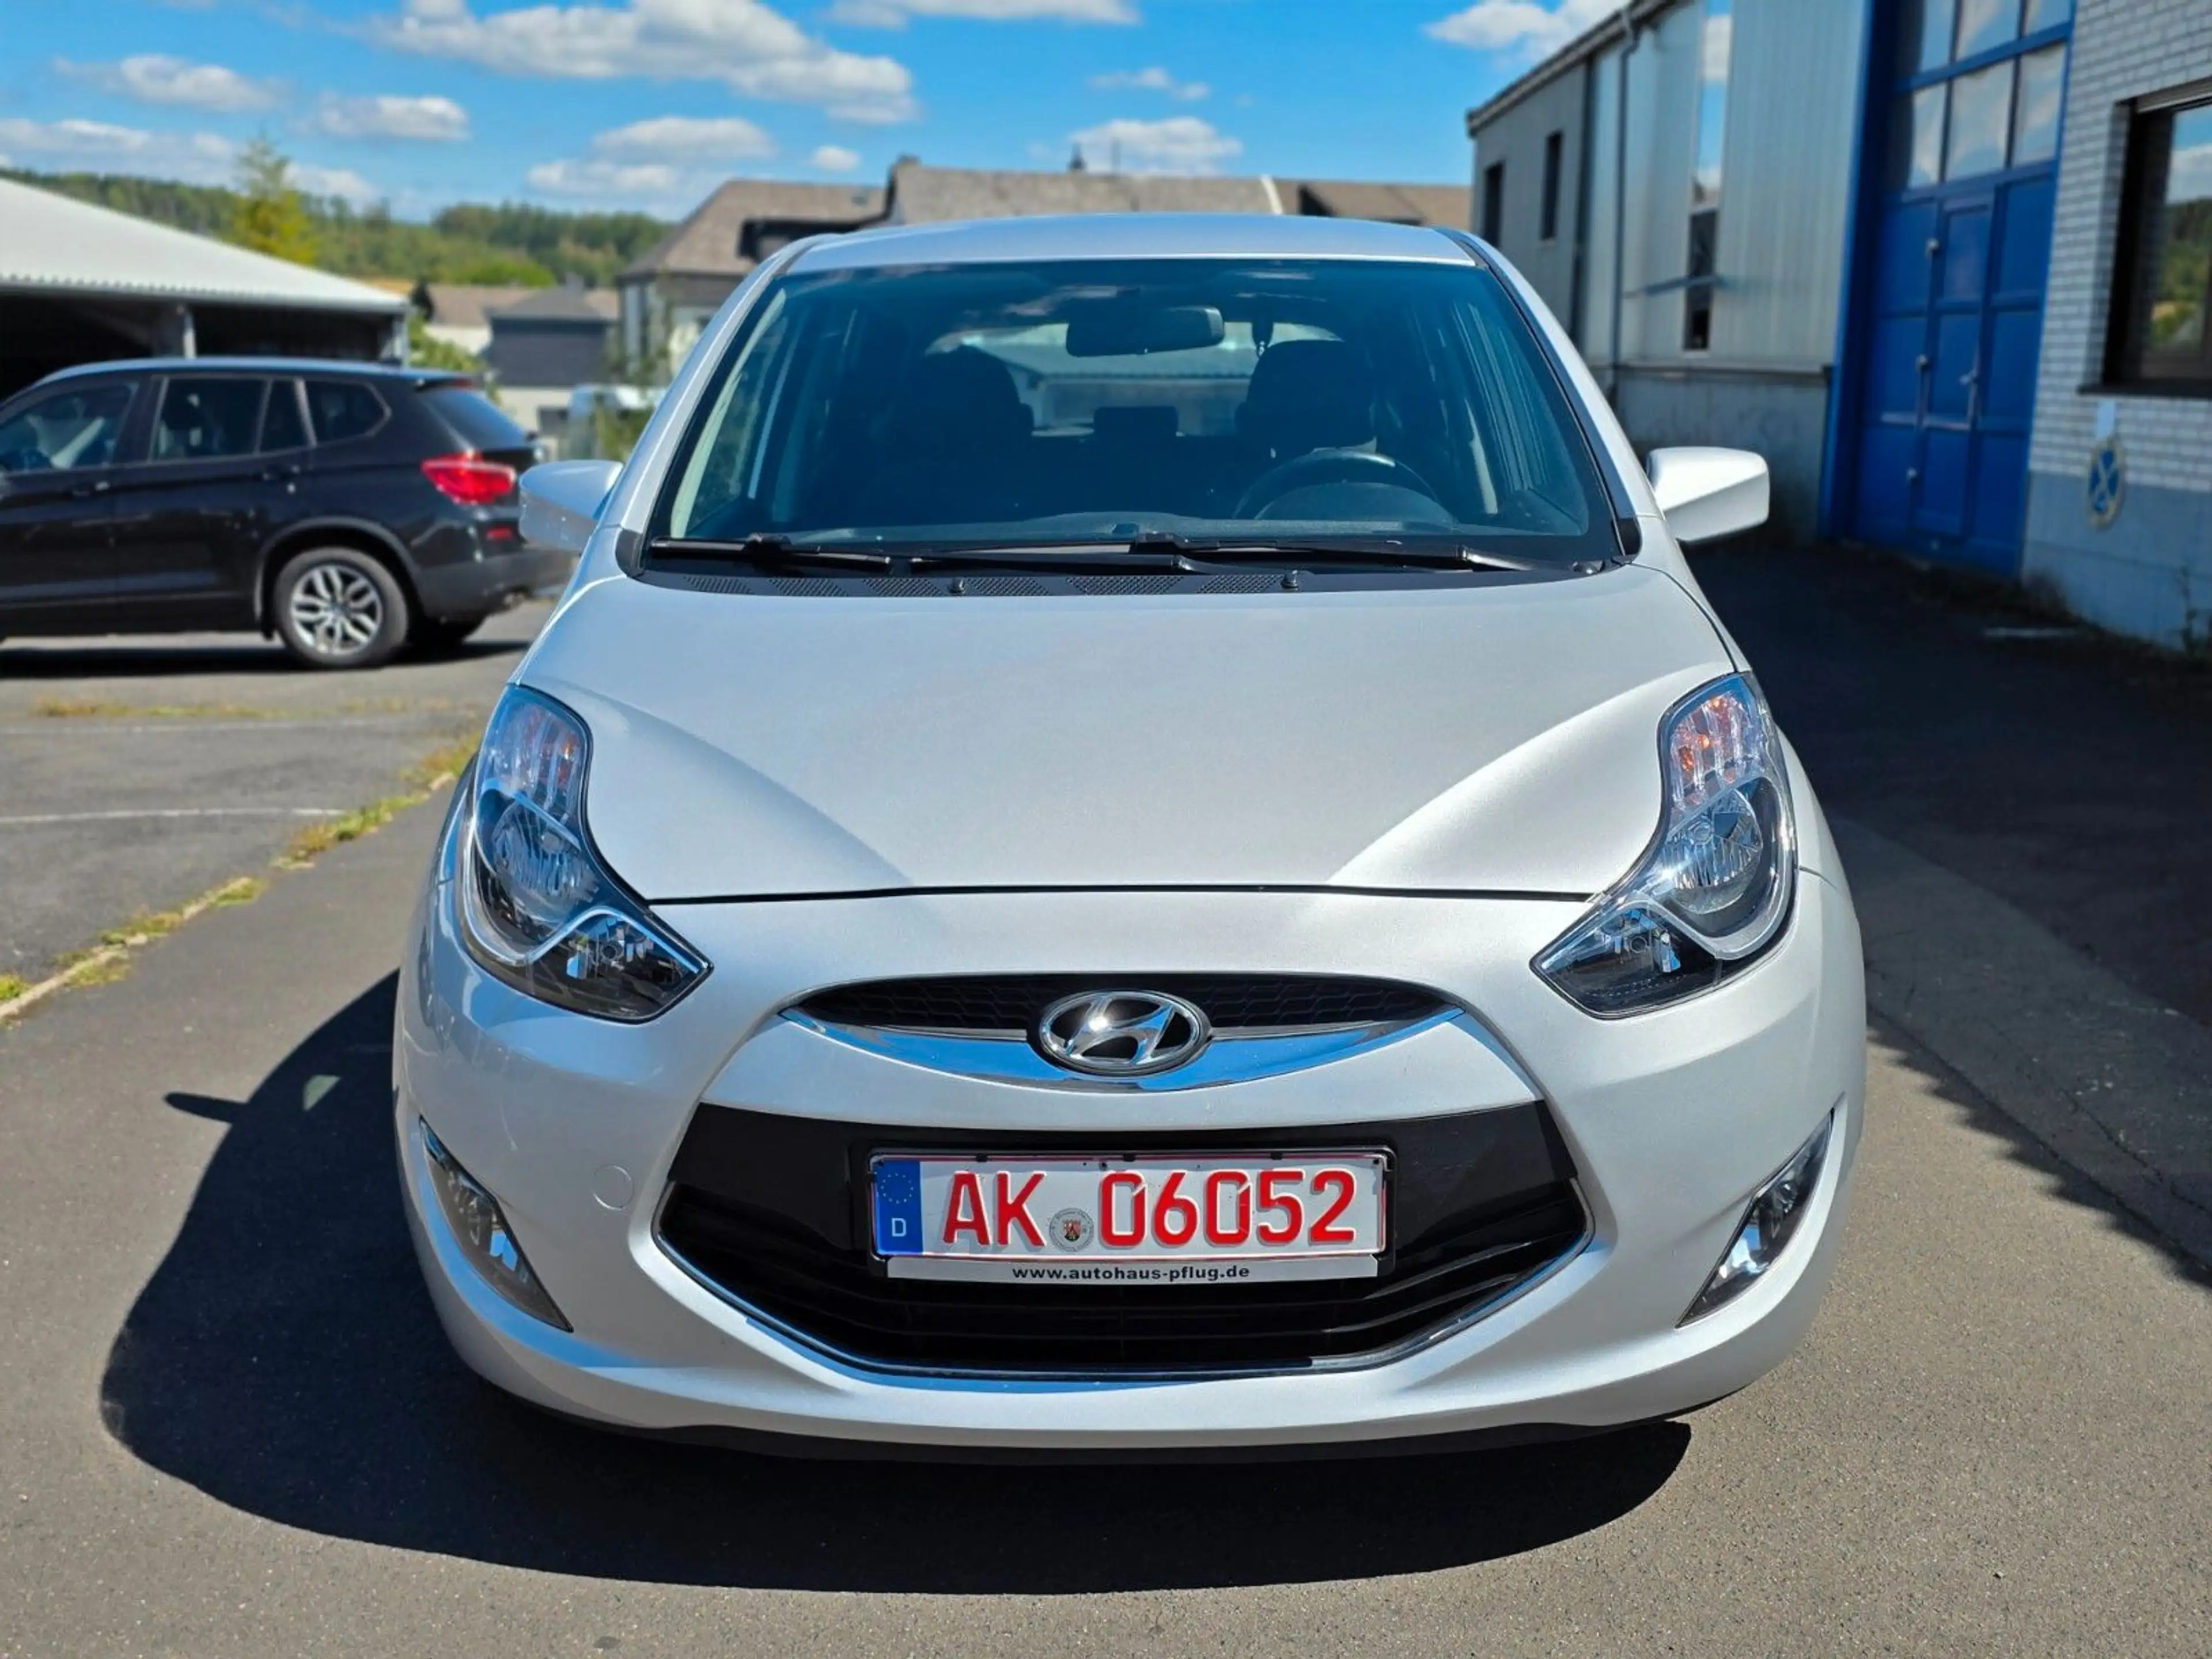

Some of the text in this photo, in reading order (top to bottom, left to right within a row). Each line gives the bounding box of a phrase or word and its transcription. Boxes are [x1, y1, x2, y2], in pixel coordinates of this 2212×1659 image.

[942, 1171, 1046, 1247] AK
[1100, 1169, 1357, 1247] 06052
[891, 1218, 907, 1237] D
[1012, 1266, 1250, 1282] www.autohaus-pflug.de
